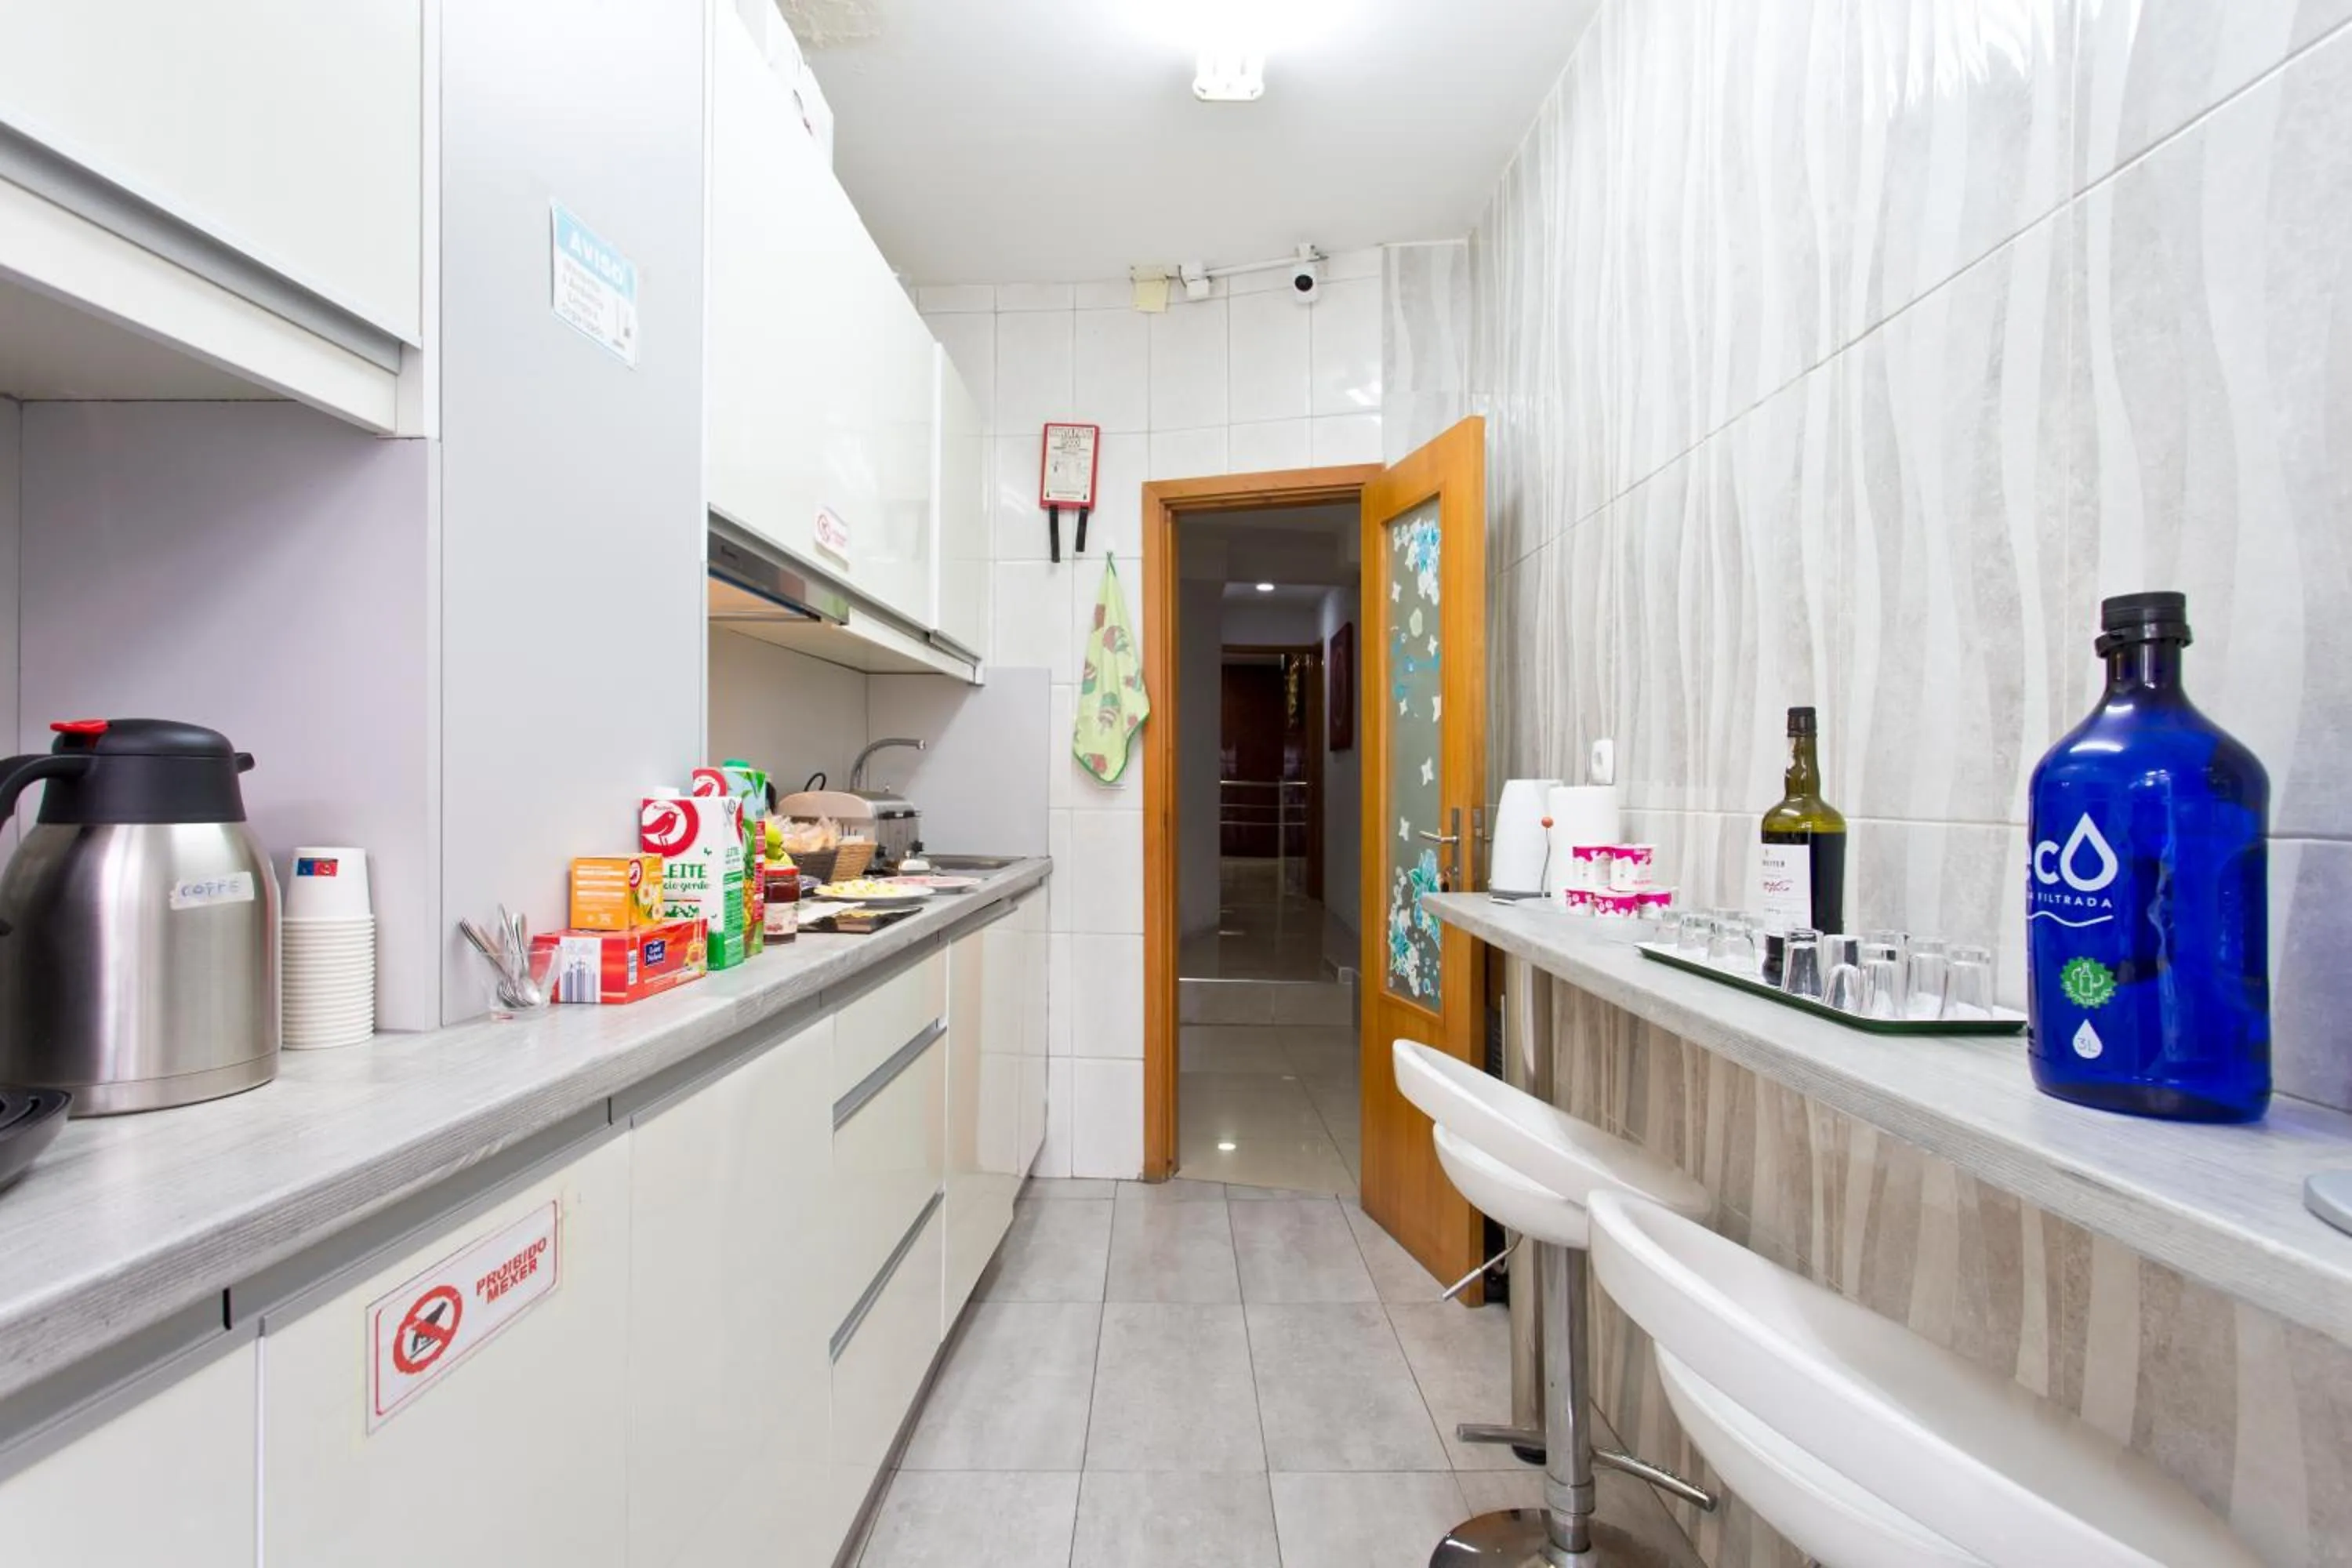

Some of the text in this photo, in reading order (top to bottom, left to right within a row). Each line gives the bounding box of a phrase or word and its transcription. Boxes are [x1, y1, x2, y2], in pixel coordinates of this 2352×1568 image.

[662, 863, 707, 879] EITE
[2026, 811, 2118, 892] CO
[2037, 891, 2113, 909] FILTRADA
[476, 1237, 546, 1297] PROIBIDO
[487, 1258, 537, 1305] MEXER
